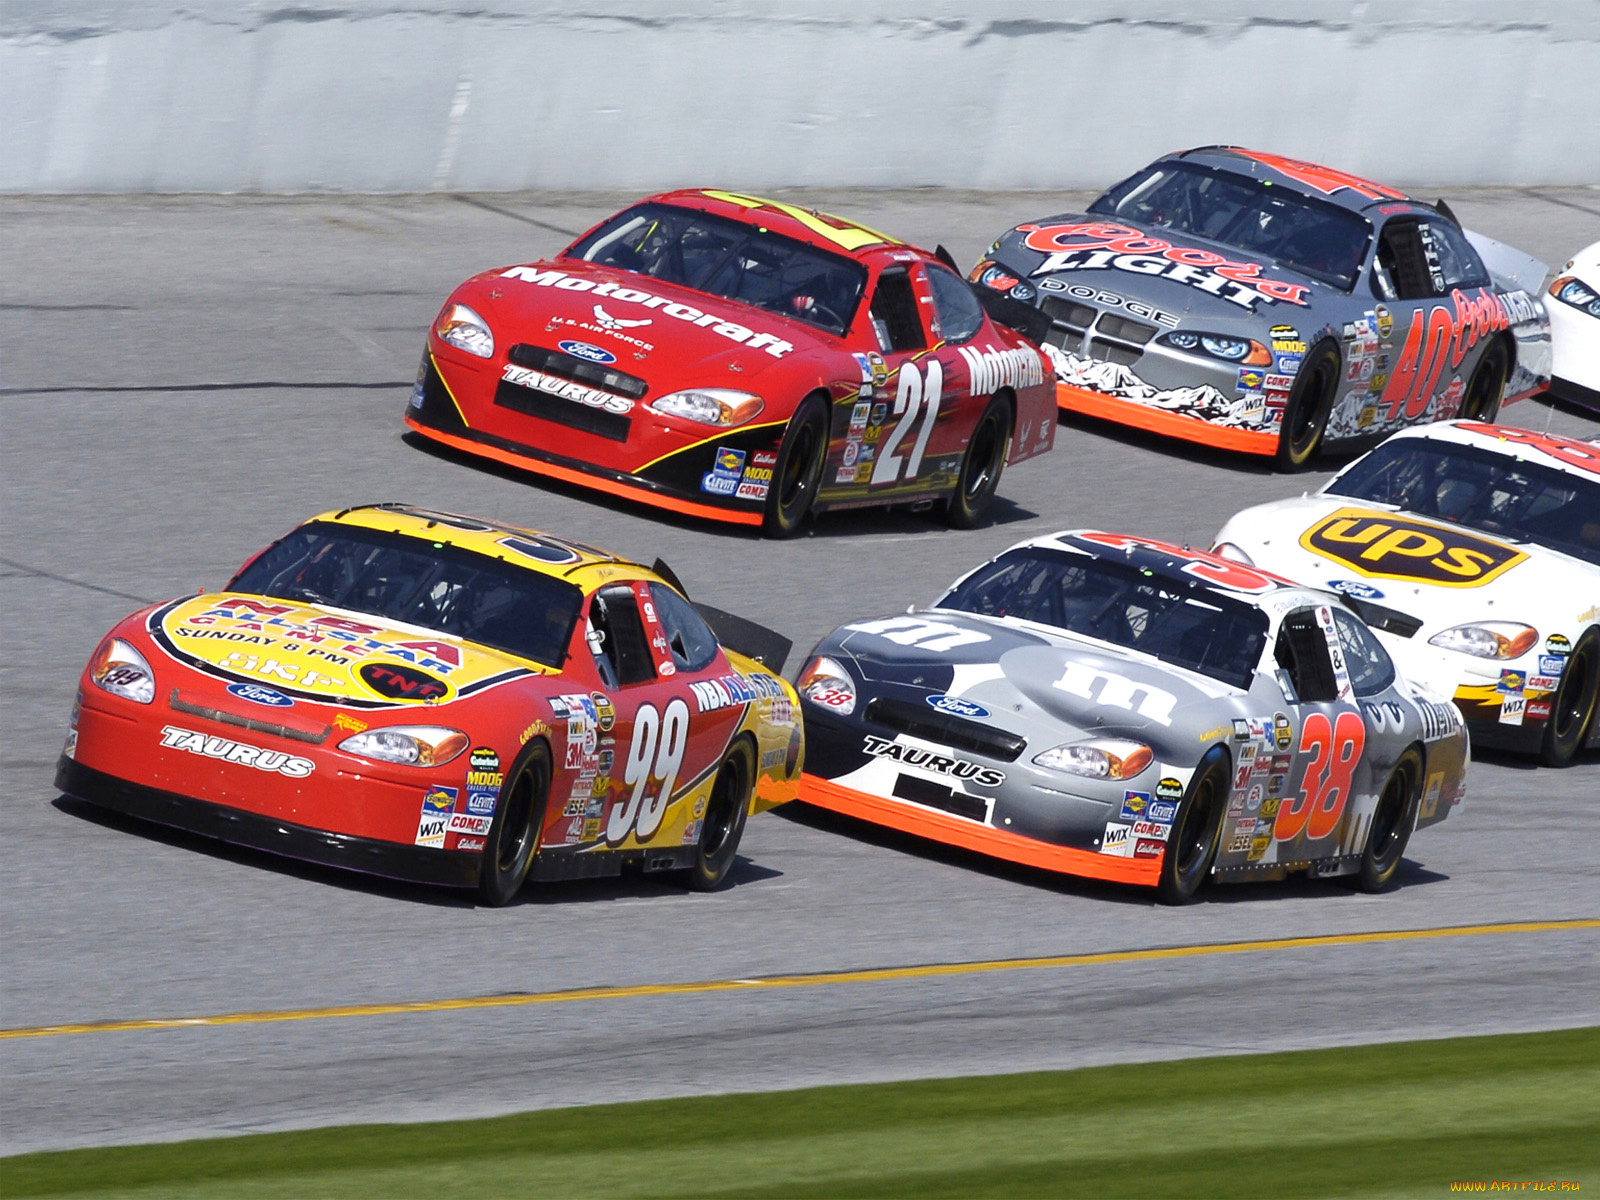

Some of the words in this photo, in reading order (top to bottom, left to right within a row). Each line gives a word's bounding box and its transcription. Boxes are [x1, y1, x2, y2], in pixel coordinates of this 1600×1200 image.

[1016, 223, 1311, 305] Coors
[1029, 250, 1276, 310] LIGHT
[502, 266, 794, 359] Motorcraft
[1038, 277, 1182, 329] DODGE
[551, 315, 577, 328] U.S.
[579, 321, 608, 336] AIR
[610, 329, 655, 352] FORCE
[1272, 340, 1306, 353] MOOG
[566, 341, 605, 362] Ford
[1379, 305, 1453, 423] 40
[503, 363, 634, 414] TAURUS
[1265, 376, 1291, 389] COMP
[871, 360, 943, 485] 21
[705, 474, 738, 491] CLEVITE
[1320, 518, 1495, 576] ups
[1334, 582, 1376, 598] Ford
[174, 626, 278, 646] SUNDAY
[282, 641, 301, 652] 8
[305, 648, 350, 665] PM
[187, 616, 372, 657] GAME
[845, 617, 992, 653] m
[217, 651, 346, 688] SKF
[369, 665, 444, 696] TNT
[236, 683, 283, 705] Ford
[689, 679, 732, 713] NBA
[812, 690, 853, 706] 38
[934, 695, 980, 716] Ford
[1052, 661, 1181, 726] m
[1503, 699, 1525, 715] WIX
[161, 726, 315, 778] TAURUS
[864, 734, 1007, 788] TAURUS
[466, 771, 503, 787] MOOG
[606, 699, 690, 845] 99
[1273, 712, 1365, 842] 38
[469, 792, 496, 811] CLEVITE
[1149, 802, 1175, 819] CLEVITE
[420, 821, 446, 838] WIX
[451, 816, 484, 831] COMP
[1106, 827, 1130, 844] WIX
[1134, 822, 1162, 835] COMP
